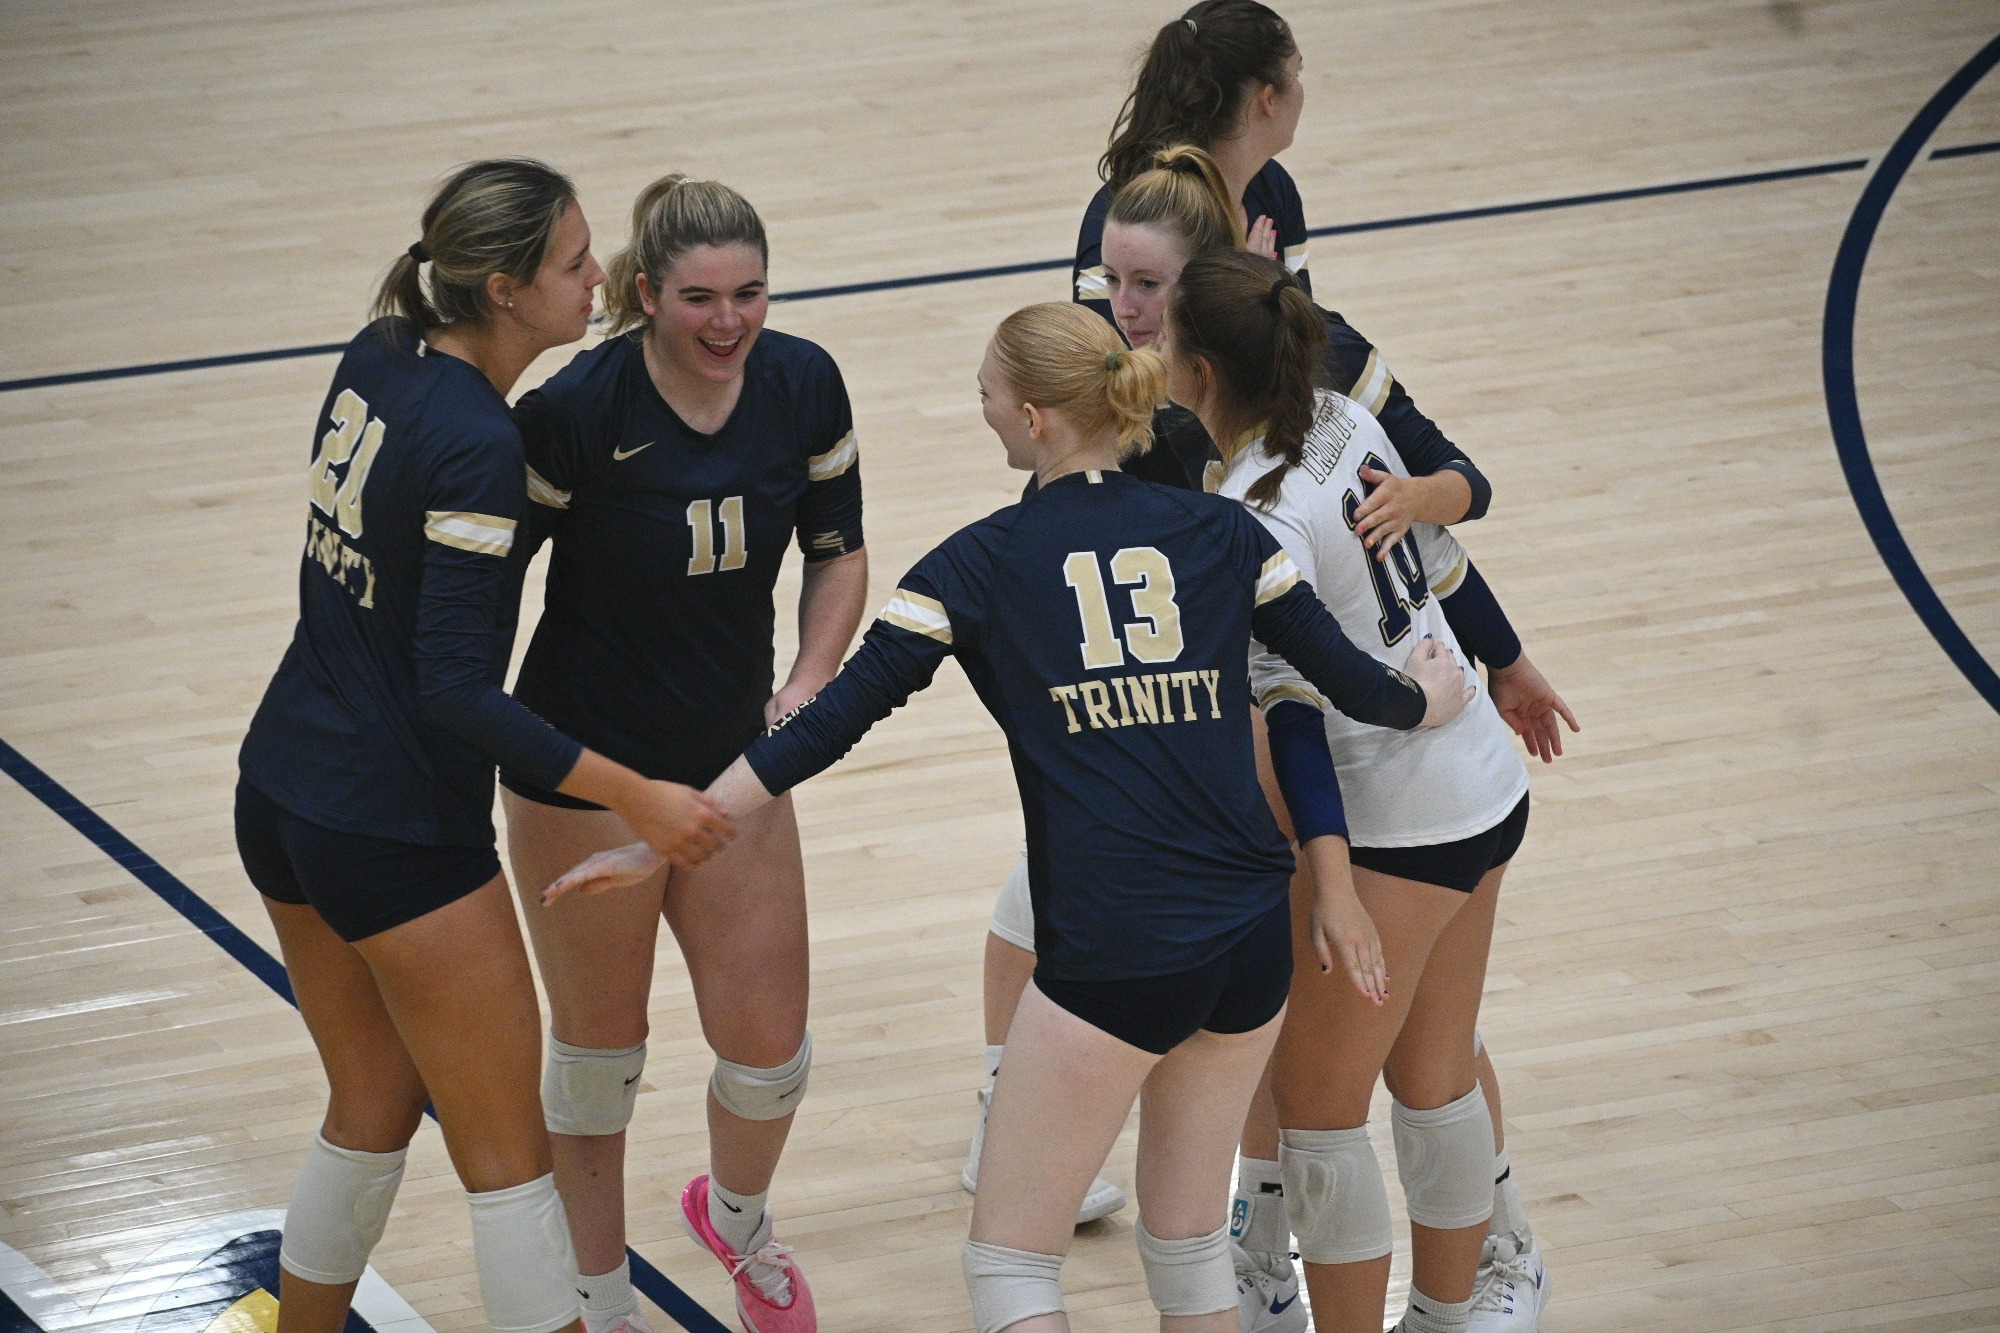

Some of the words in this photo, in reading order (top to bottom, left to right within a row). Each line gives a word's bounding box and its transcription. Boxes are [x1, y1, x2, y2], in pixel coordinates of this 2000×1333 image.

[686, 495, 749, 577] 11
[1062, 546, 1185, 670] 13
[1048, 669, 1222, 734] TRINITY
